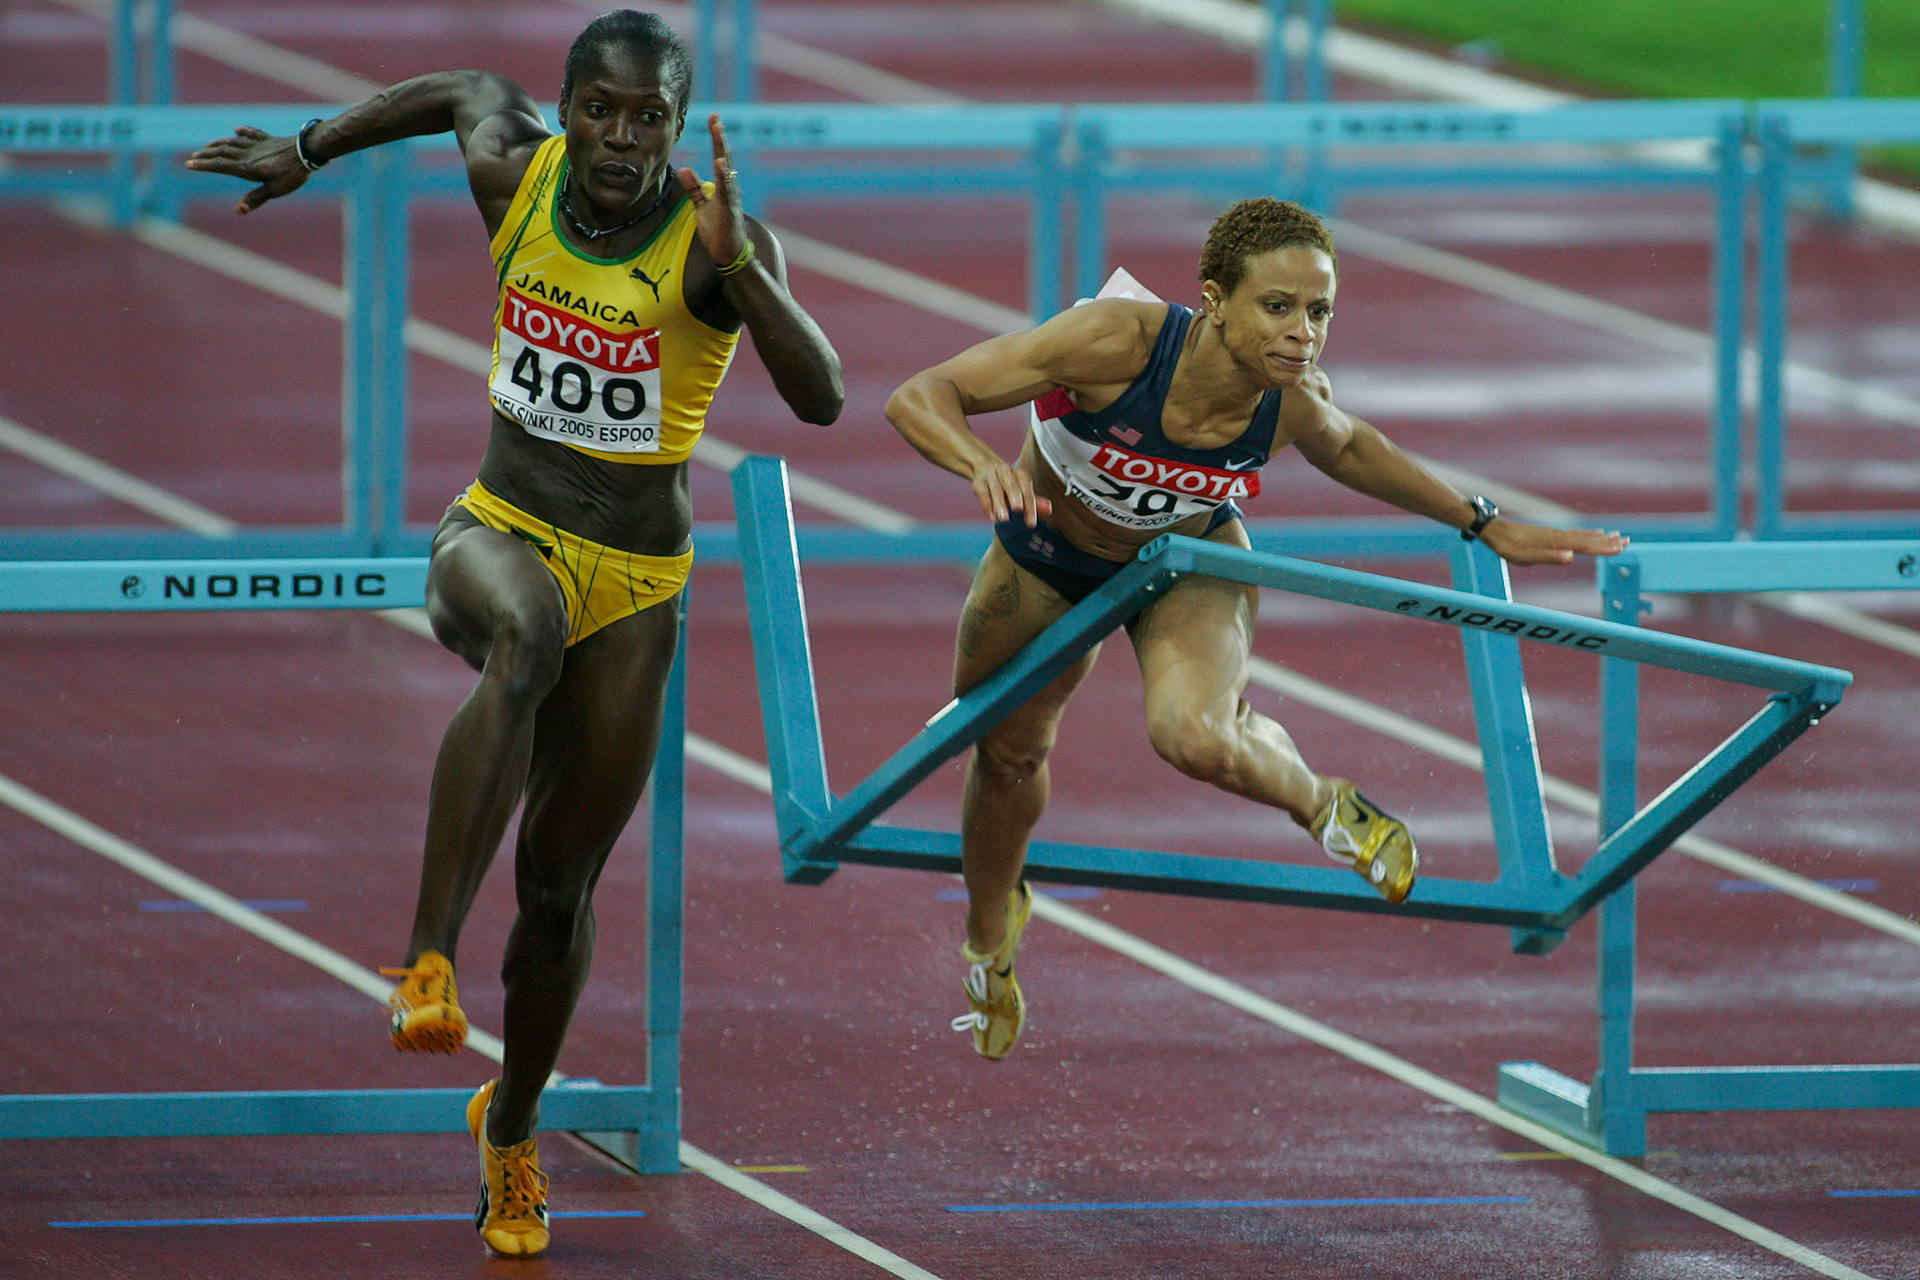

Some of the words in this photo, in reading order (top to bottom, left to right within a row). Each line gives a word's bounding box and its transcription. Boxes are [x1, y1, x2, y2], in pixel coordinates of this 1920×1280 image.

[515, 274, 640, 327] JAMAICA
[510, 297, 652, 367] TOYOTA
[511, 346, 646, 421] 400
[558, 418, 594, 438] 2005
[600, 426, 654, 443] ESPOO
[1104, 448, 1249, 499] TOYOTA
[1135, 516, 1170, 527] 2005
[164, 573, 386, 598] NORDIC
[1427, 605, 1608, 650] NORDIC
